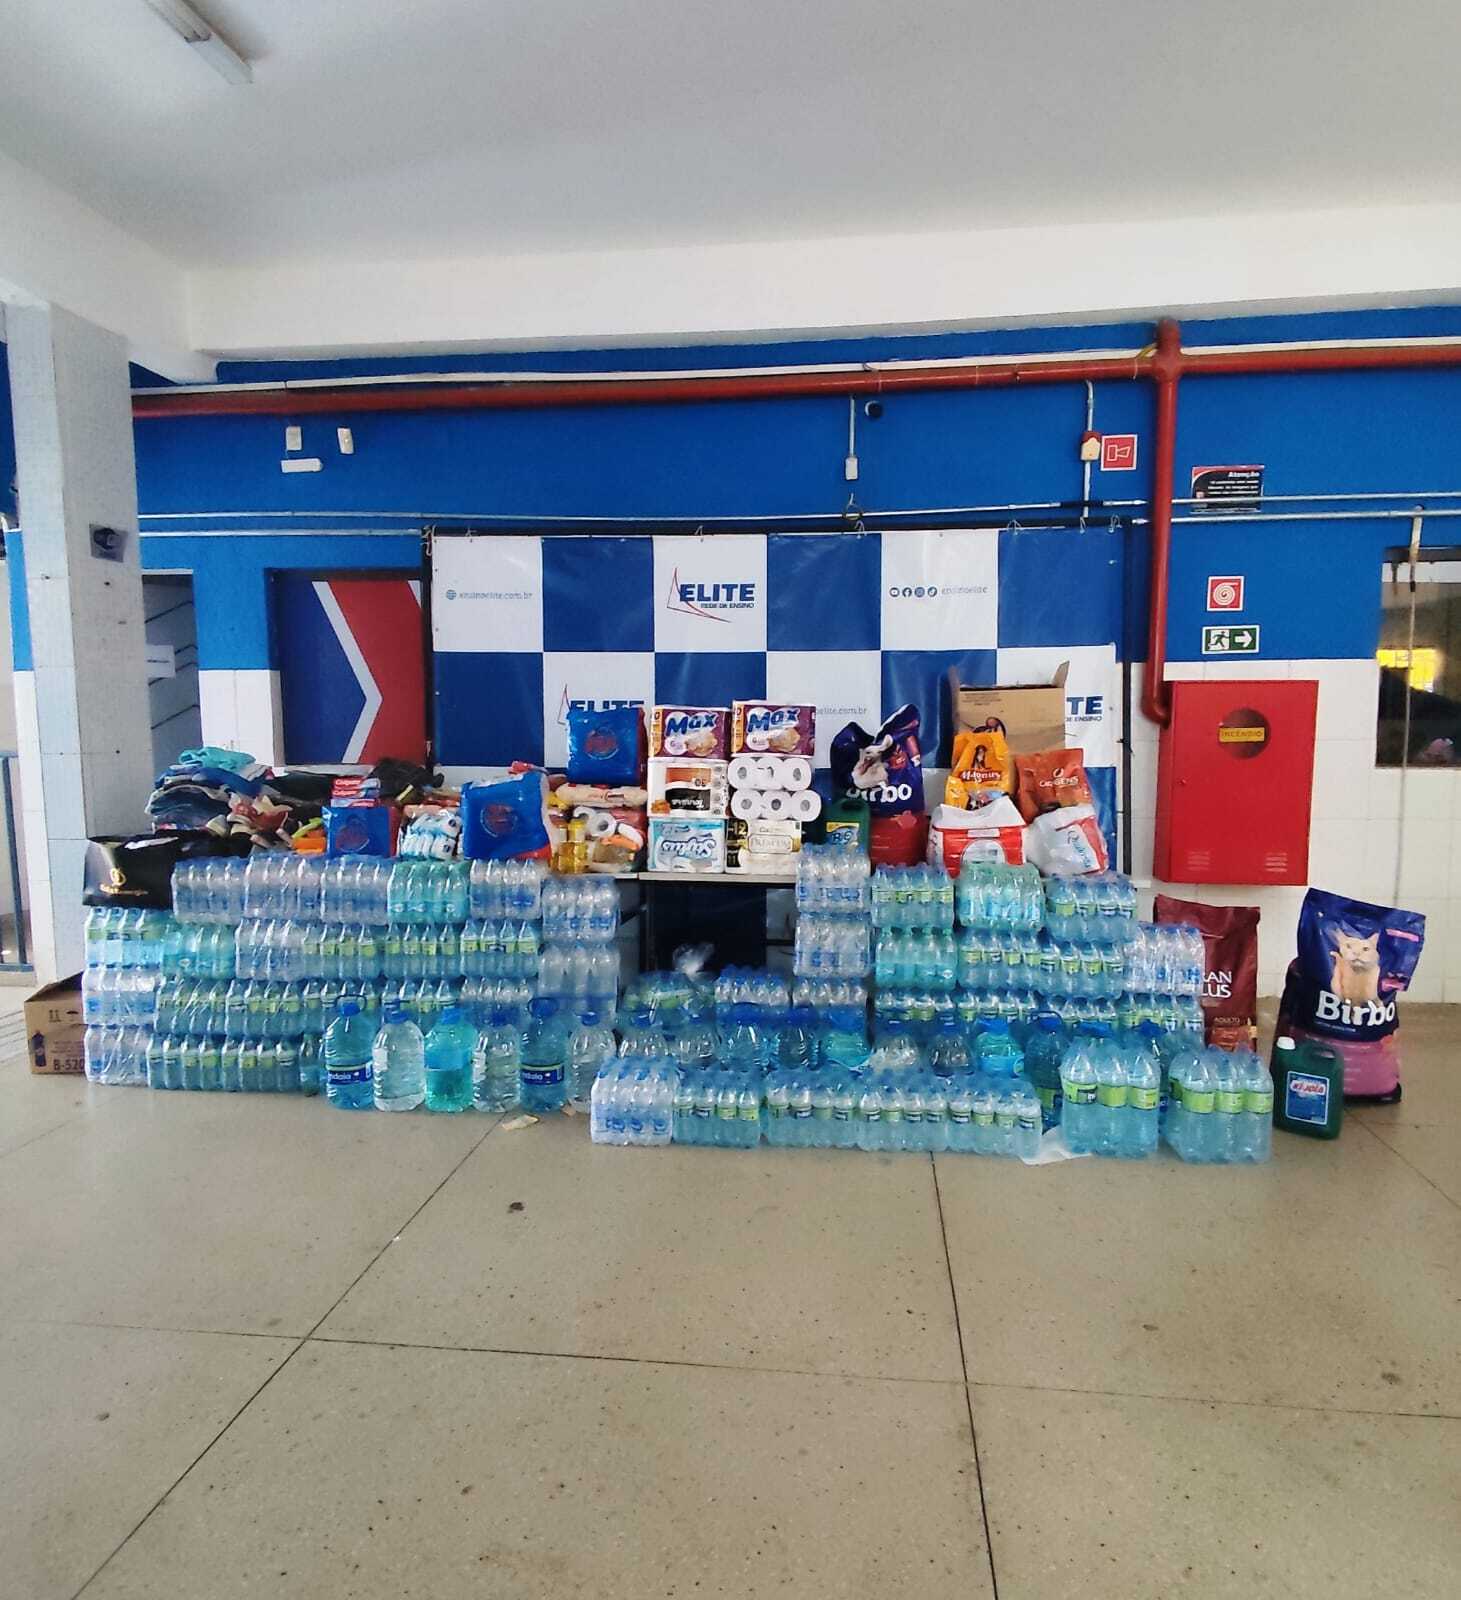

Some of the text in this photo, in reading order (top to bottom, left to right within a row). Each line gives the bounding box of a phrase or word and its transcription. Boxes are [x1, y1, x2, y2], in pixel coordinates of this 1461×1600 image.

[680, 583, 755, 602] ELITE
[665, 713, 718, 737] Max
[747, 708, 799, 733] Max
[1315, 990, 1396, 1026] Birbo
